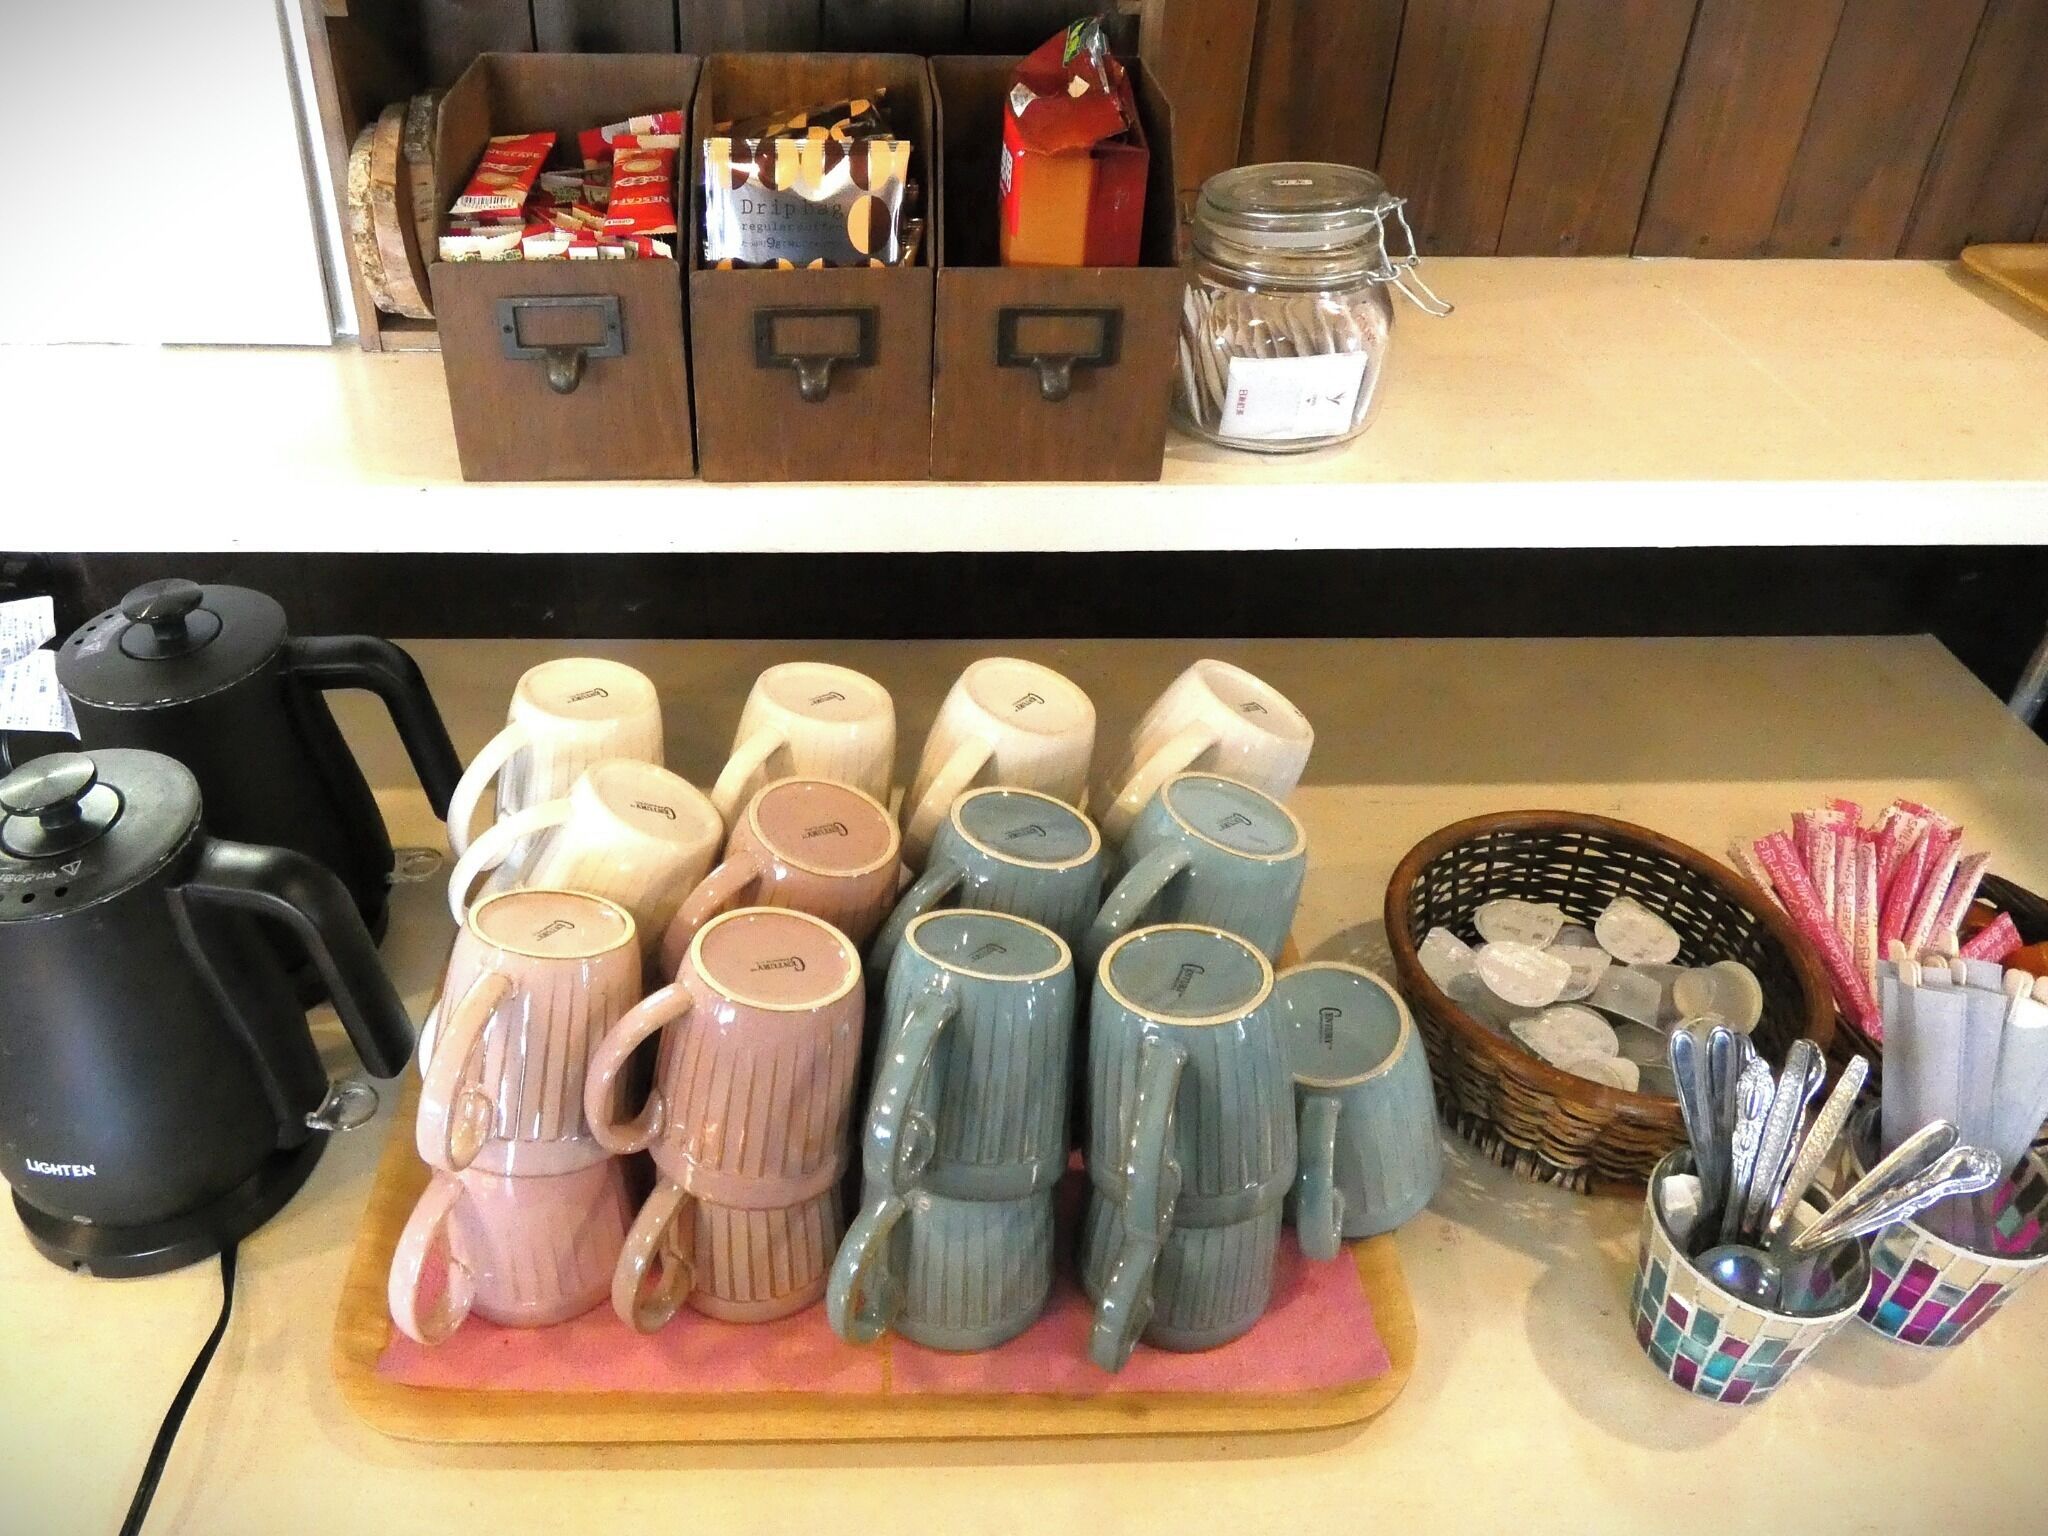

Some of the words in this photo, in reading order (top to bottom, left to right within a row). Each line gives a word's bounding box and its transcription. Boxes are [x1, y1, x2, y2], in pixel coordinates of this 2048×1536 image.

[741, 198, 796, 220] Drip
[801, 199, 844, 220] bag
[1815, 922, 1844, 964] SWEET
[757, 956, 805, 971] CENTURY
[26, 1158, 96, 1177] LIGHTEN
